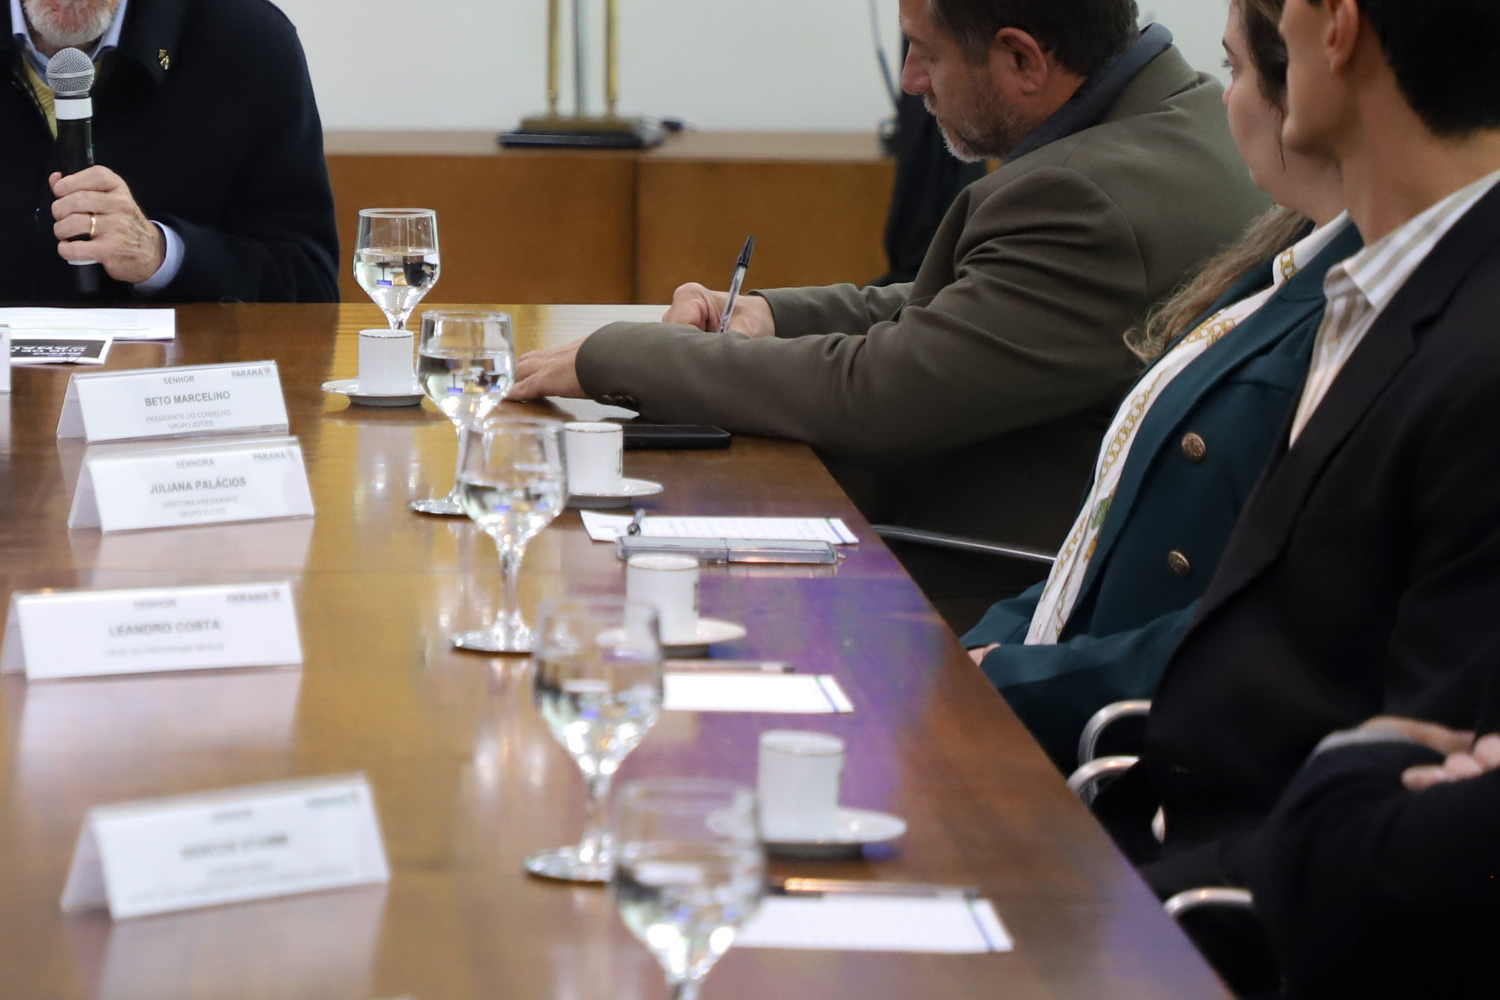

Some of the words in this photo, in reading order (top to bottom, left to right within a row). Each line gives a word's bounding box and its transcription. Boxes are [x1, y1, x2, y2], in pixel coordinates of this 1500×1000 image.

[163, 375, 195, 385] SENHOR
[145, 395, 172, 407] BETO
[174, 391, 231, 405] MARCELINO
[149, 481, 193, 495] JULIANA
[195, 477, 247, 491] PALÁCIOS
[108, 621, 173, 638] LEANDRO
[175, 619, 221, 634] COSTA
